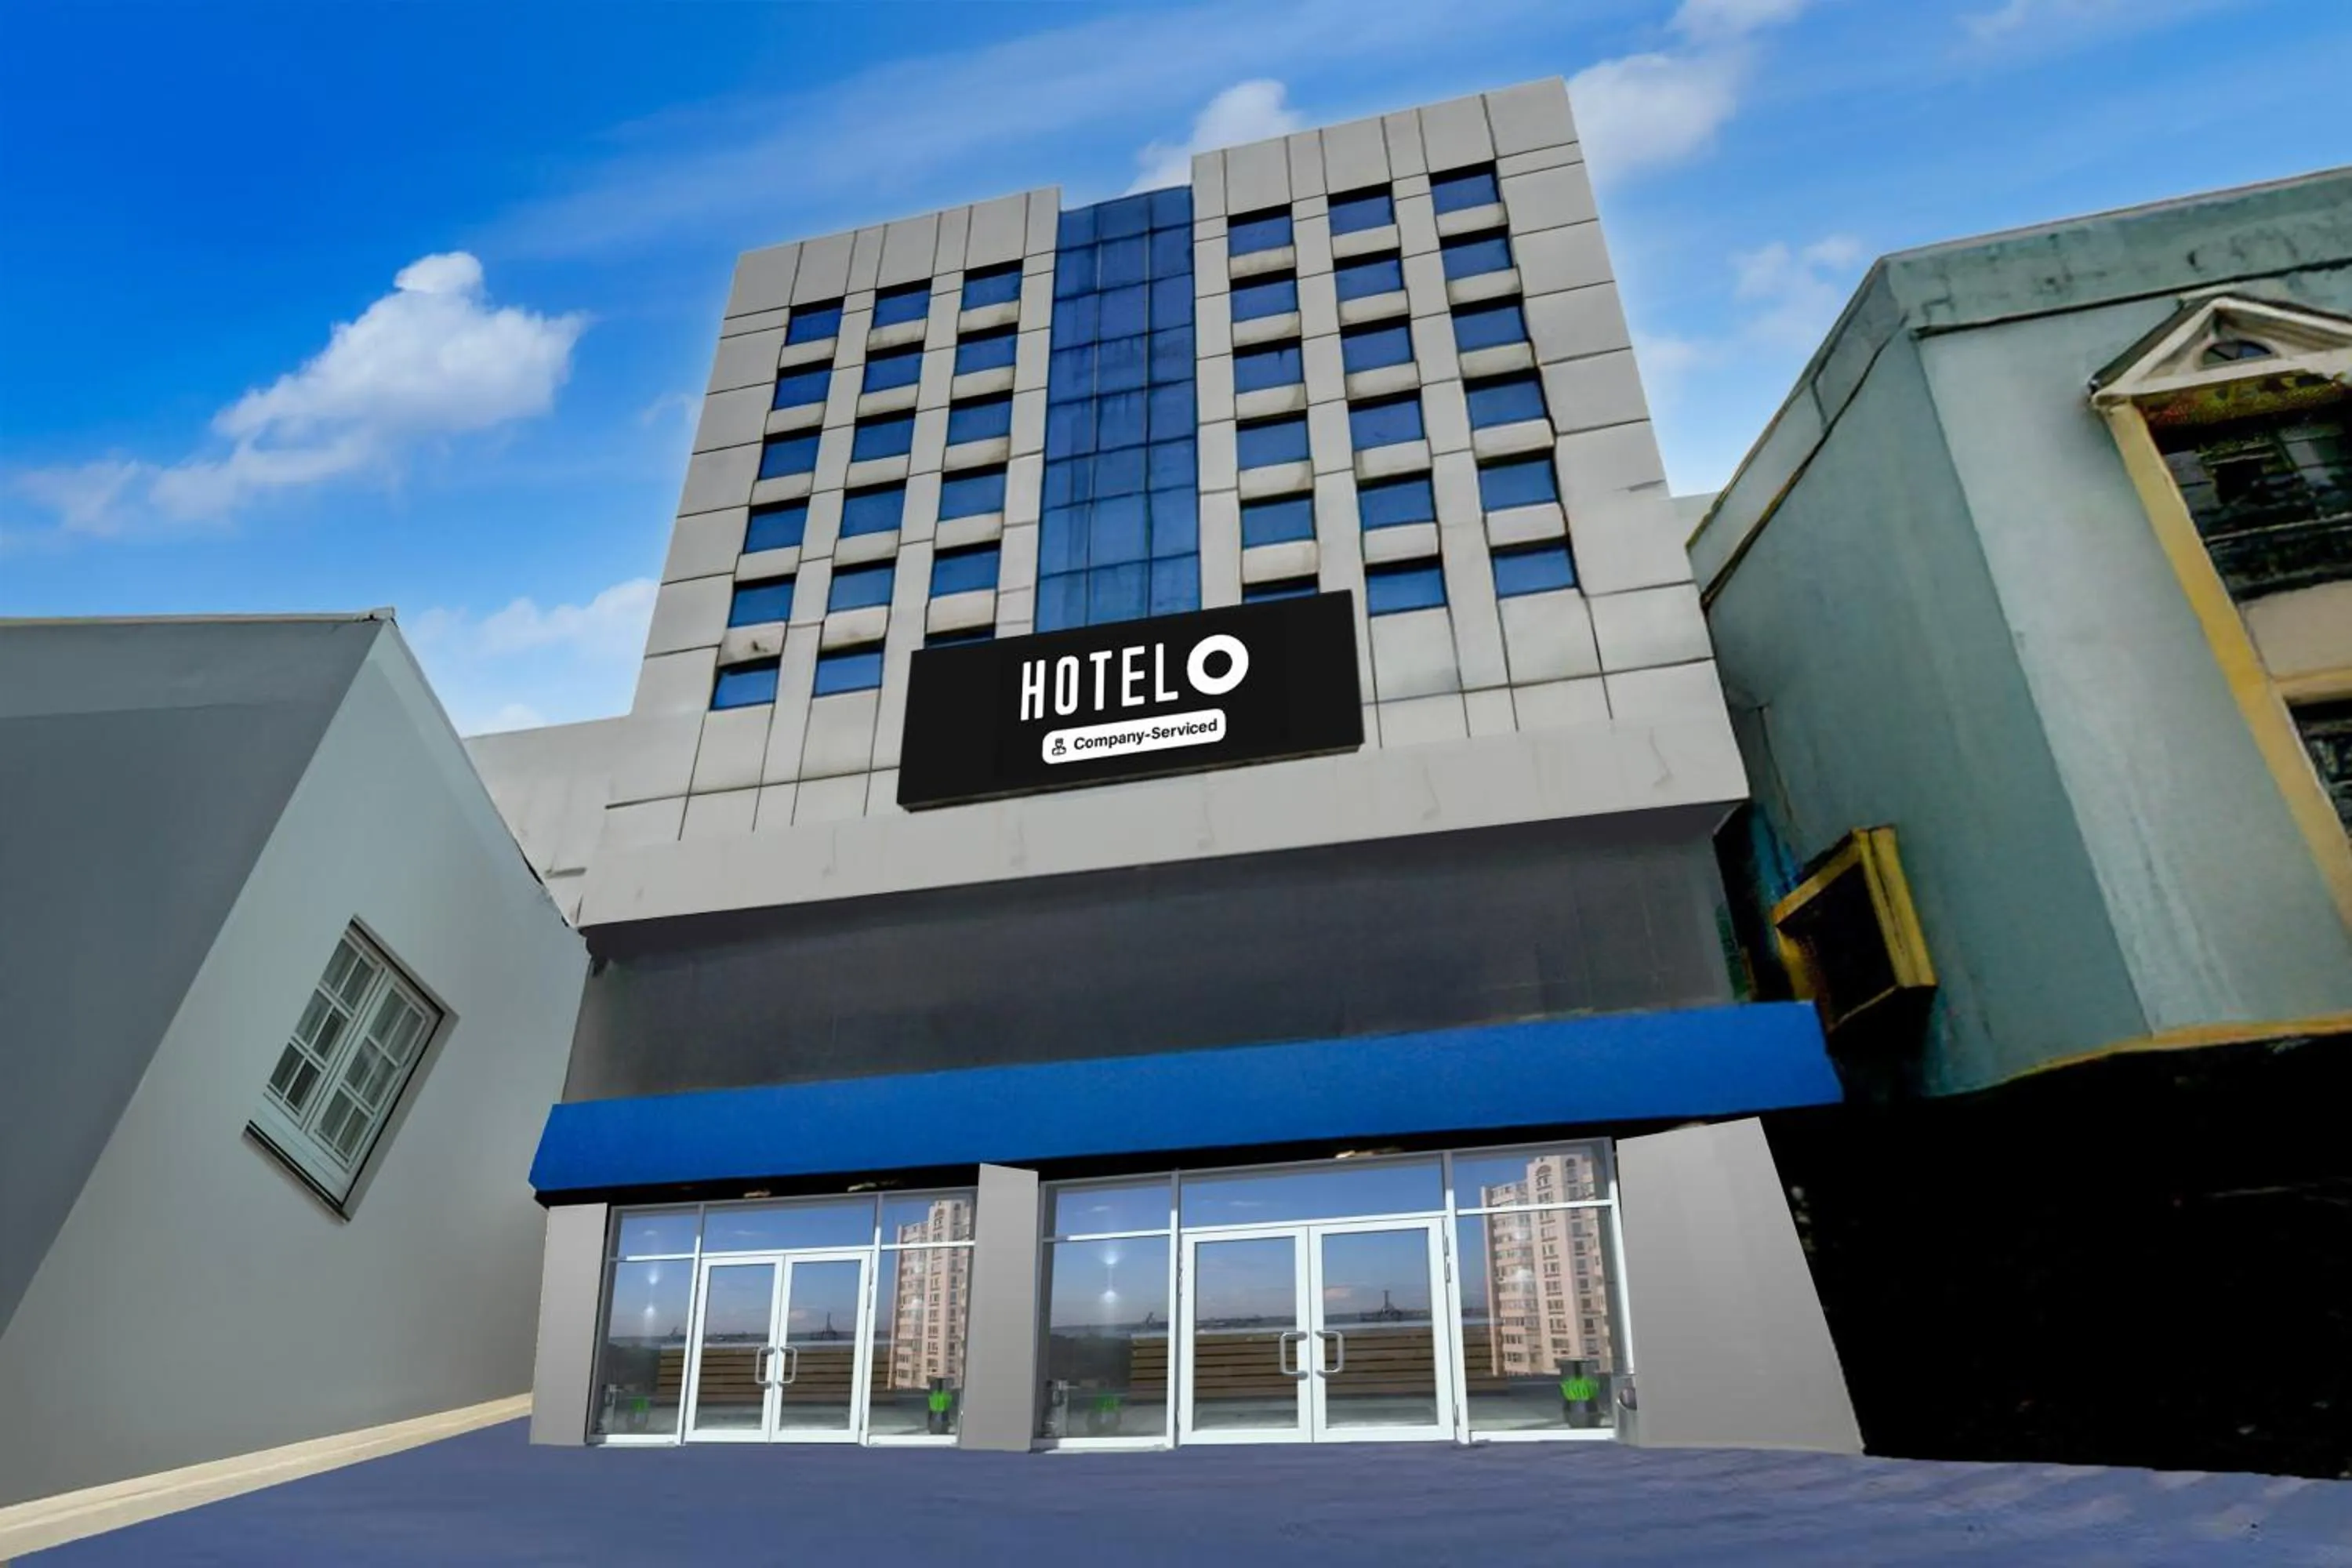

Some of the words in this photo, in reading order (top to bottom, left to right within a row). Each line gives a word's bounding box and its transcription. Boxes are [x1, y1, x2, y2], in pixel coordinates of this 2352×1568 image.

[1020, 643, 1179, 721] HOTEL
[1186, 633, 1249, 695] O
[1073, 717, 1218, 751] Company-Serviced
